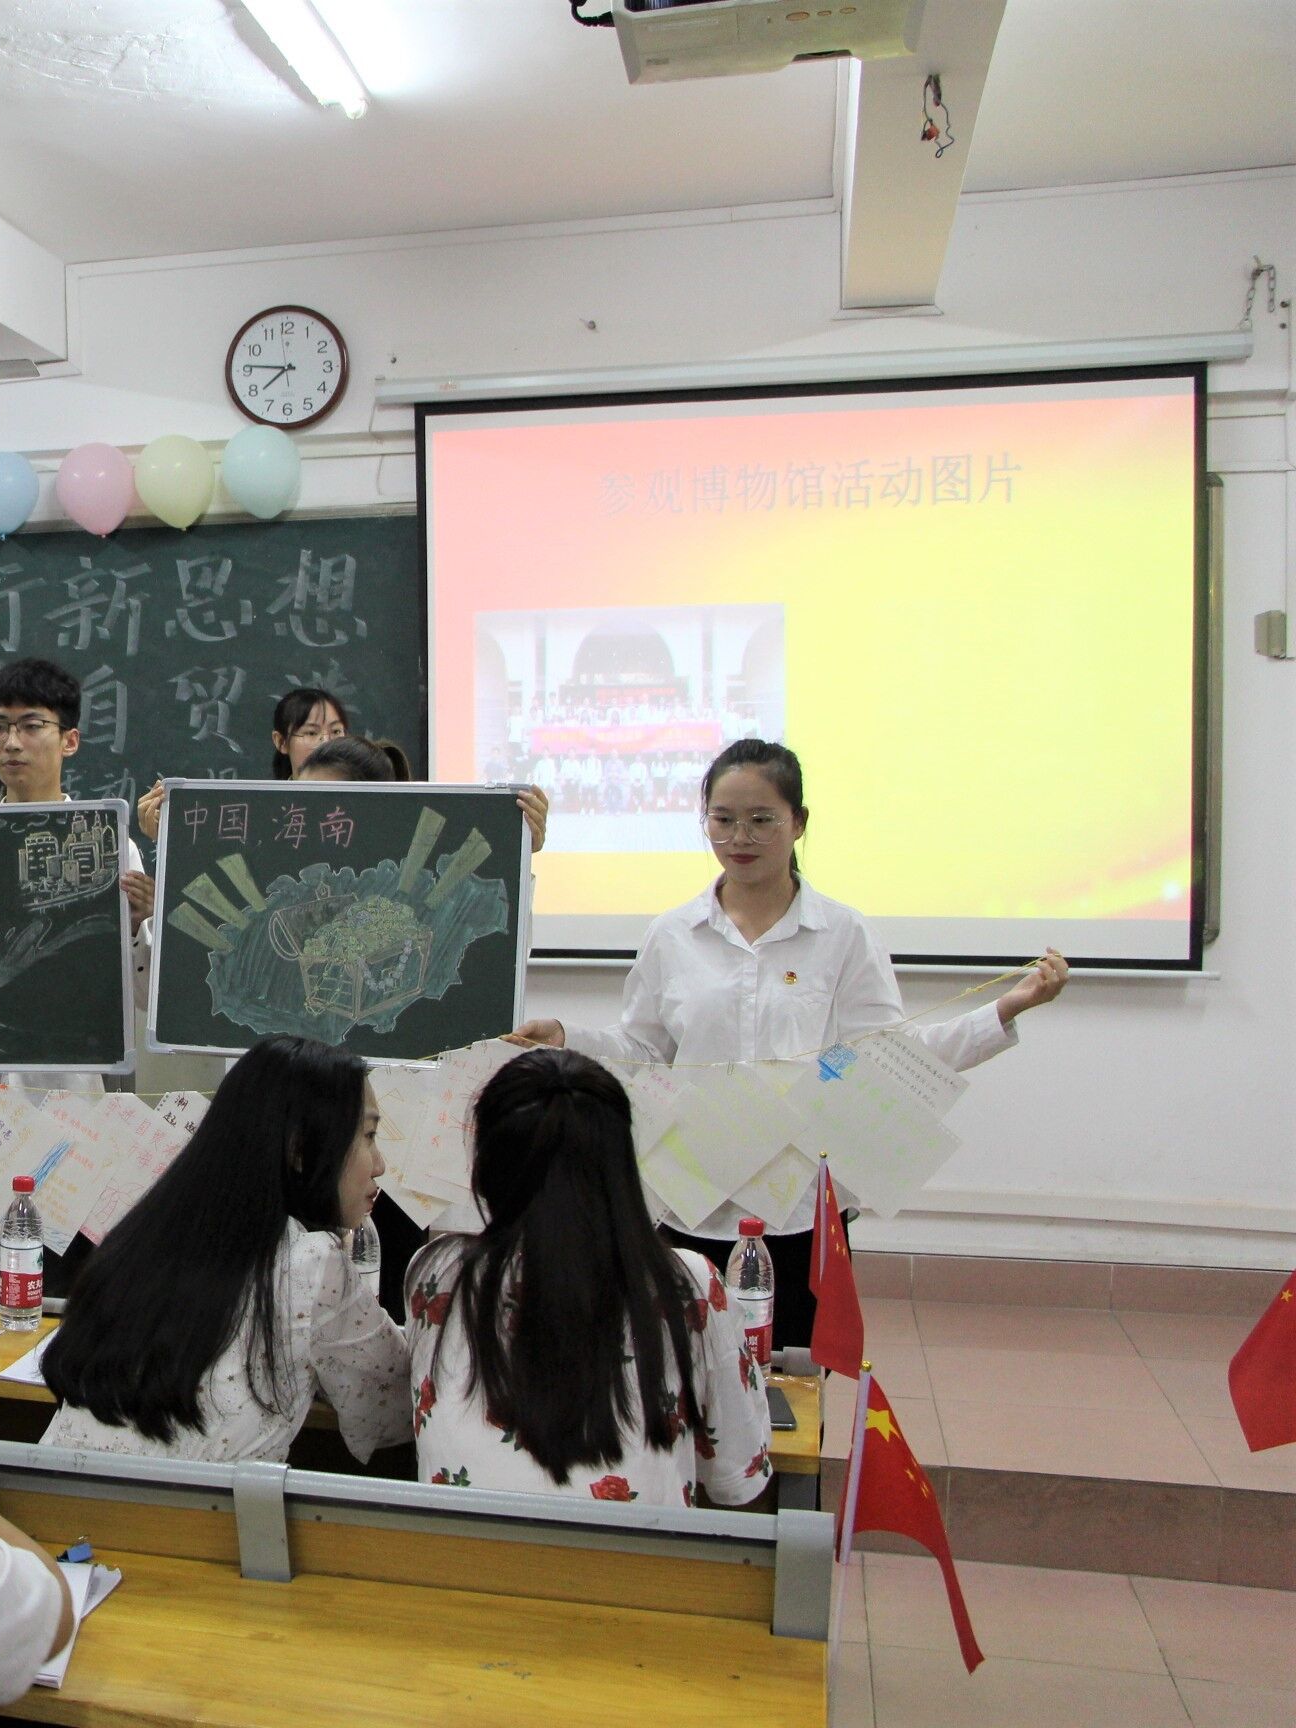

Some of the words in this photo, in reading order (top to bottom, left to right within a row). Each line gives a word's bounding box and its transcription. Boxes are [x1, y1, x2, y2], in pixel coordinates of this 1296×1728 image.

[264, 327, 274, 341] 11
[280, 321, 295, 335] 12
[248, 344, 262, 357] 10
[317, 340, 328, 354] 2
[242, 365, 253, 377] 9
[322, 360, 333, 373] 3
[248, 384, 259, 397] 8
[317, 381, 326, 394] 4
[264, 399, 275, 412] 7
[282, 403, 293, 416] 6
[302, 397, 313, 411] 5
[602, 451, 1023, 519] 参观博物馆活动图片
